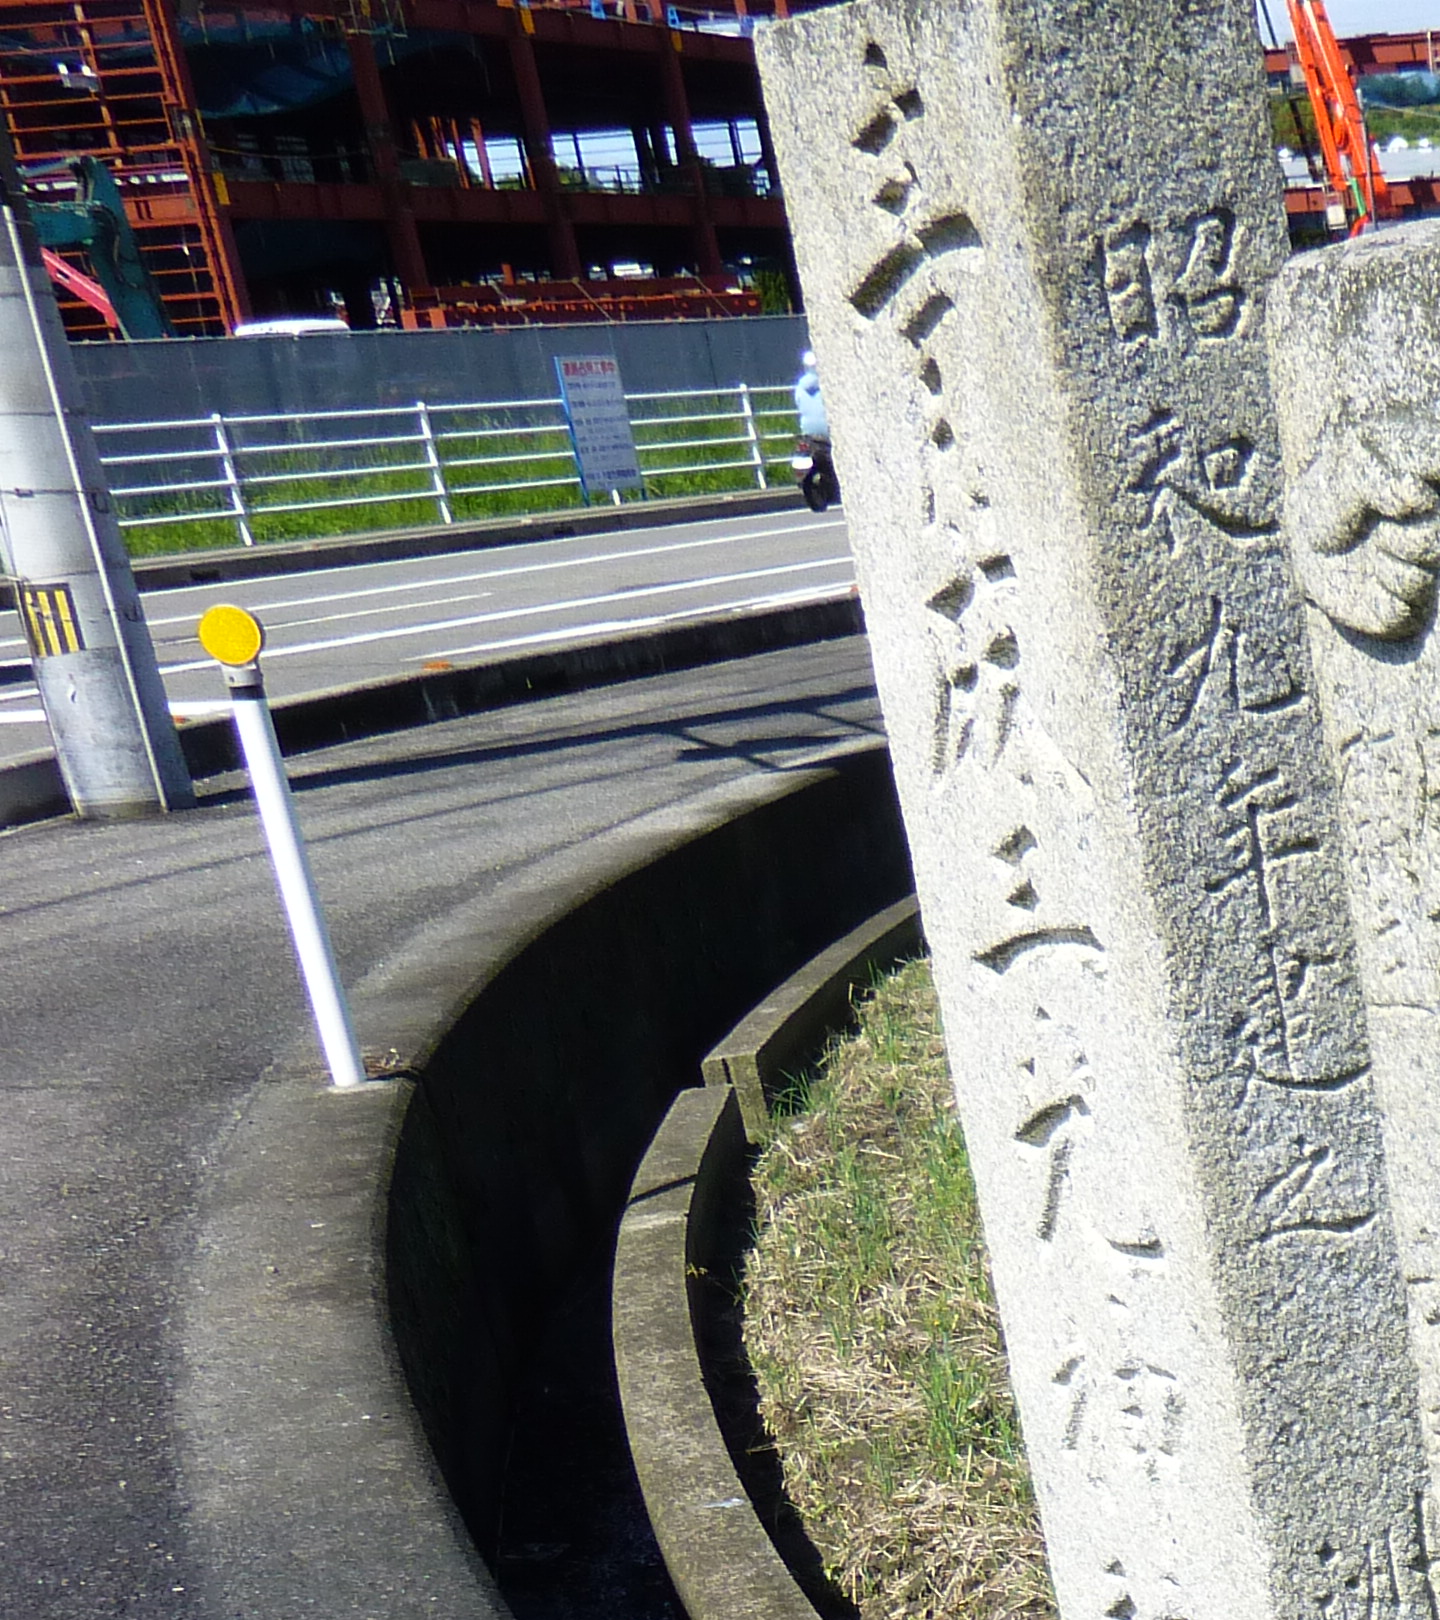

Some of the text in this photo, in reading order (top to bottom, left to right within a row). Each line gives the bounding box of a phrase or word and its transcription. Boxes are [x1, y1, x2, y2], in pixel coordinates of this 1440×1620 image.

[1100, 205, 1380, 1243] 昭和九年建之
